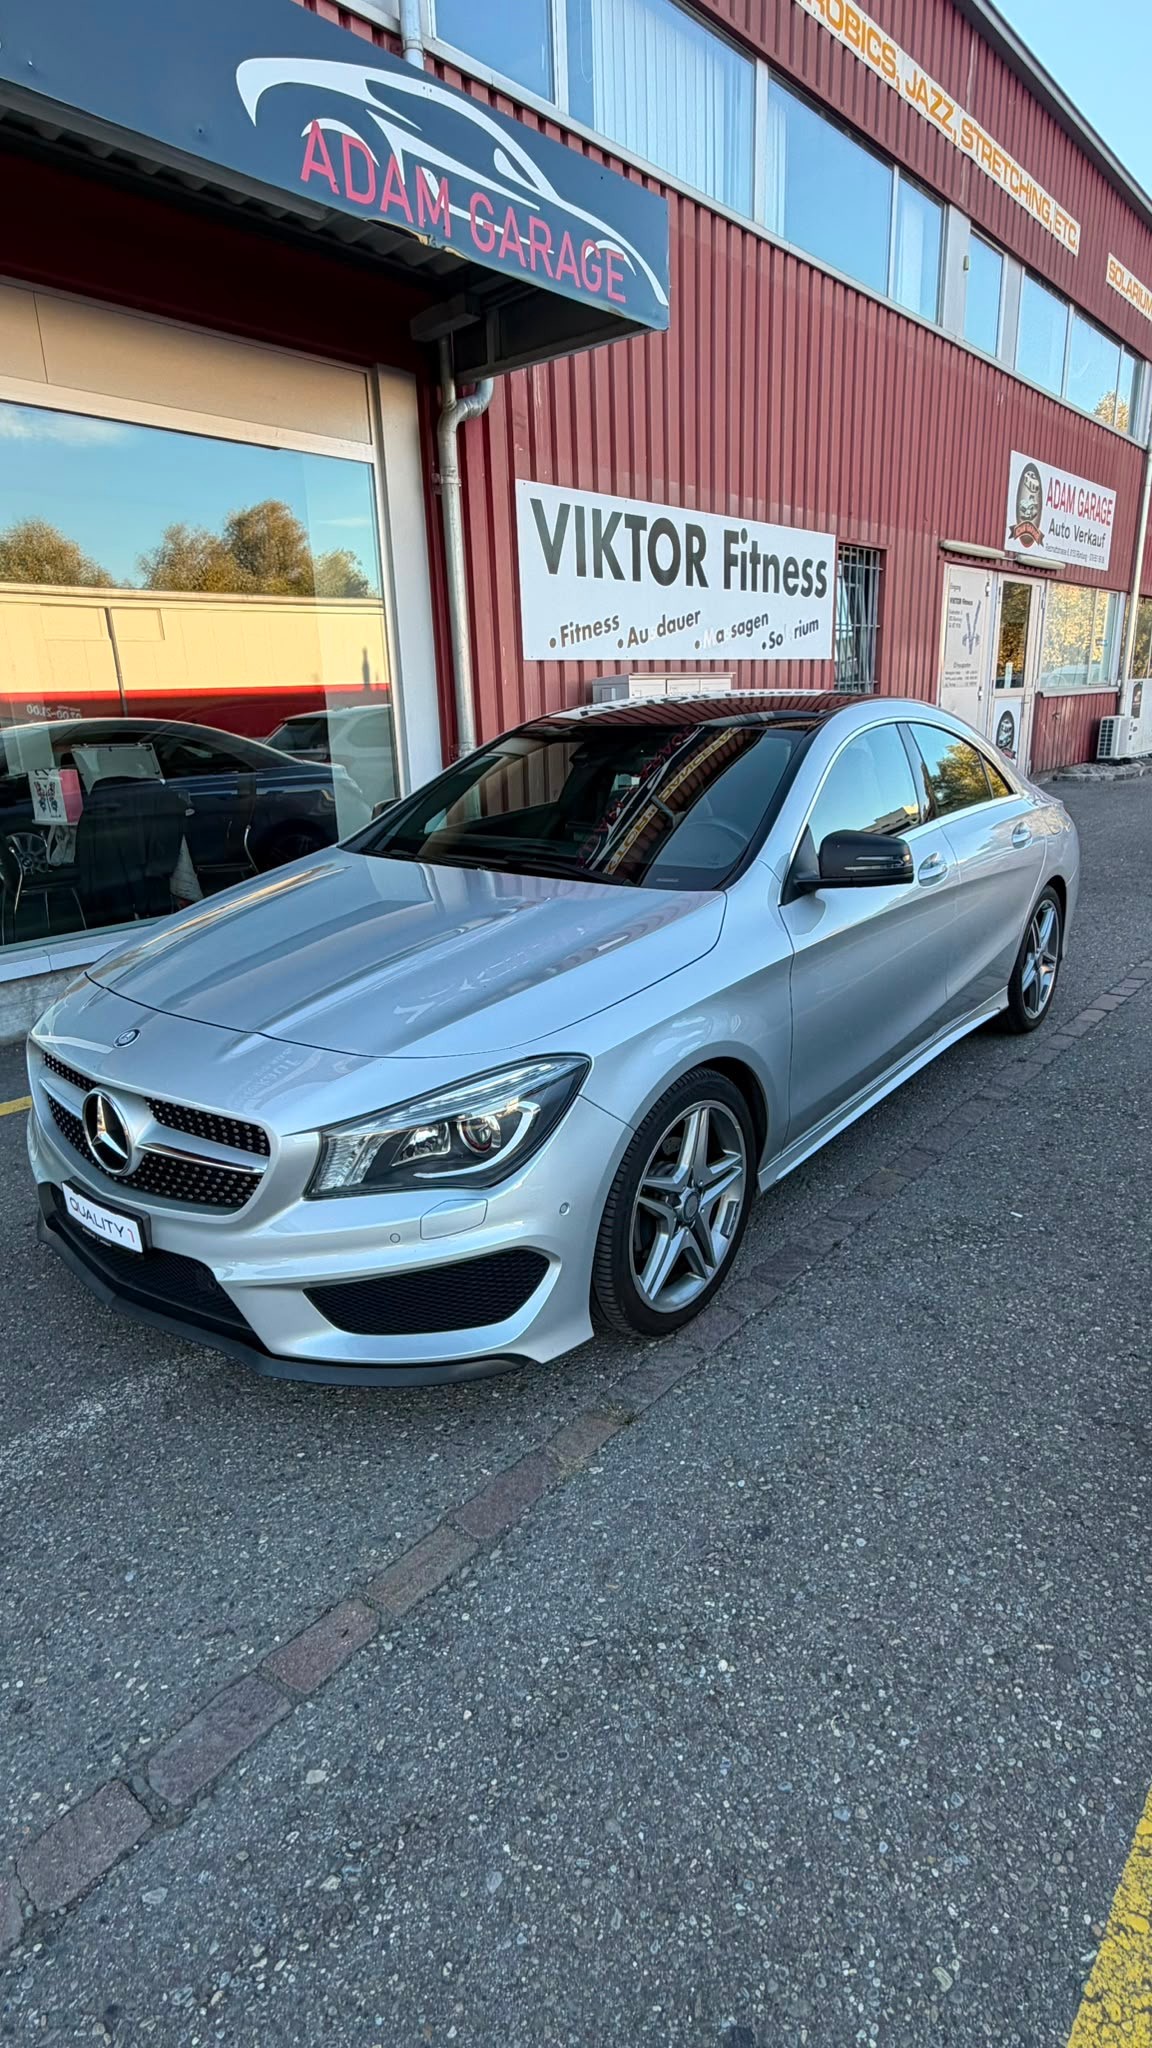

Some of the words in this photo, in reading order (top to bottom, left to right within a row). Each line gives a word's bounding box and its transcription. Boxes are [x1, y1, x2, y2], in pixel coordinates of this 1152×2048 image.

[806, 0, 900, 90] OBICS,
[905, 70, 957, 144] JAZZ,
[300, 119, 452, 239] ADAM
[469, 192, 627, 303] GARAGE
[1046, 477, 1076, 515] ADAM
[1078, 488, 1113, 526] GARAGE
[529, 498, 709, 588] VIKTOR
[723, 527, 828, 598] Fitness
[1048, 518, 1070, 539] Auto
[1074, 525, 1106, 548] Verkauf
[627, 610, 702, 648] Audauer
[69, 1197, 124, 1238] QUALITY
[127, 1228, 136, 1244] 1
